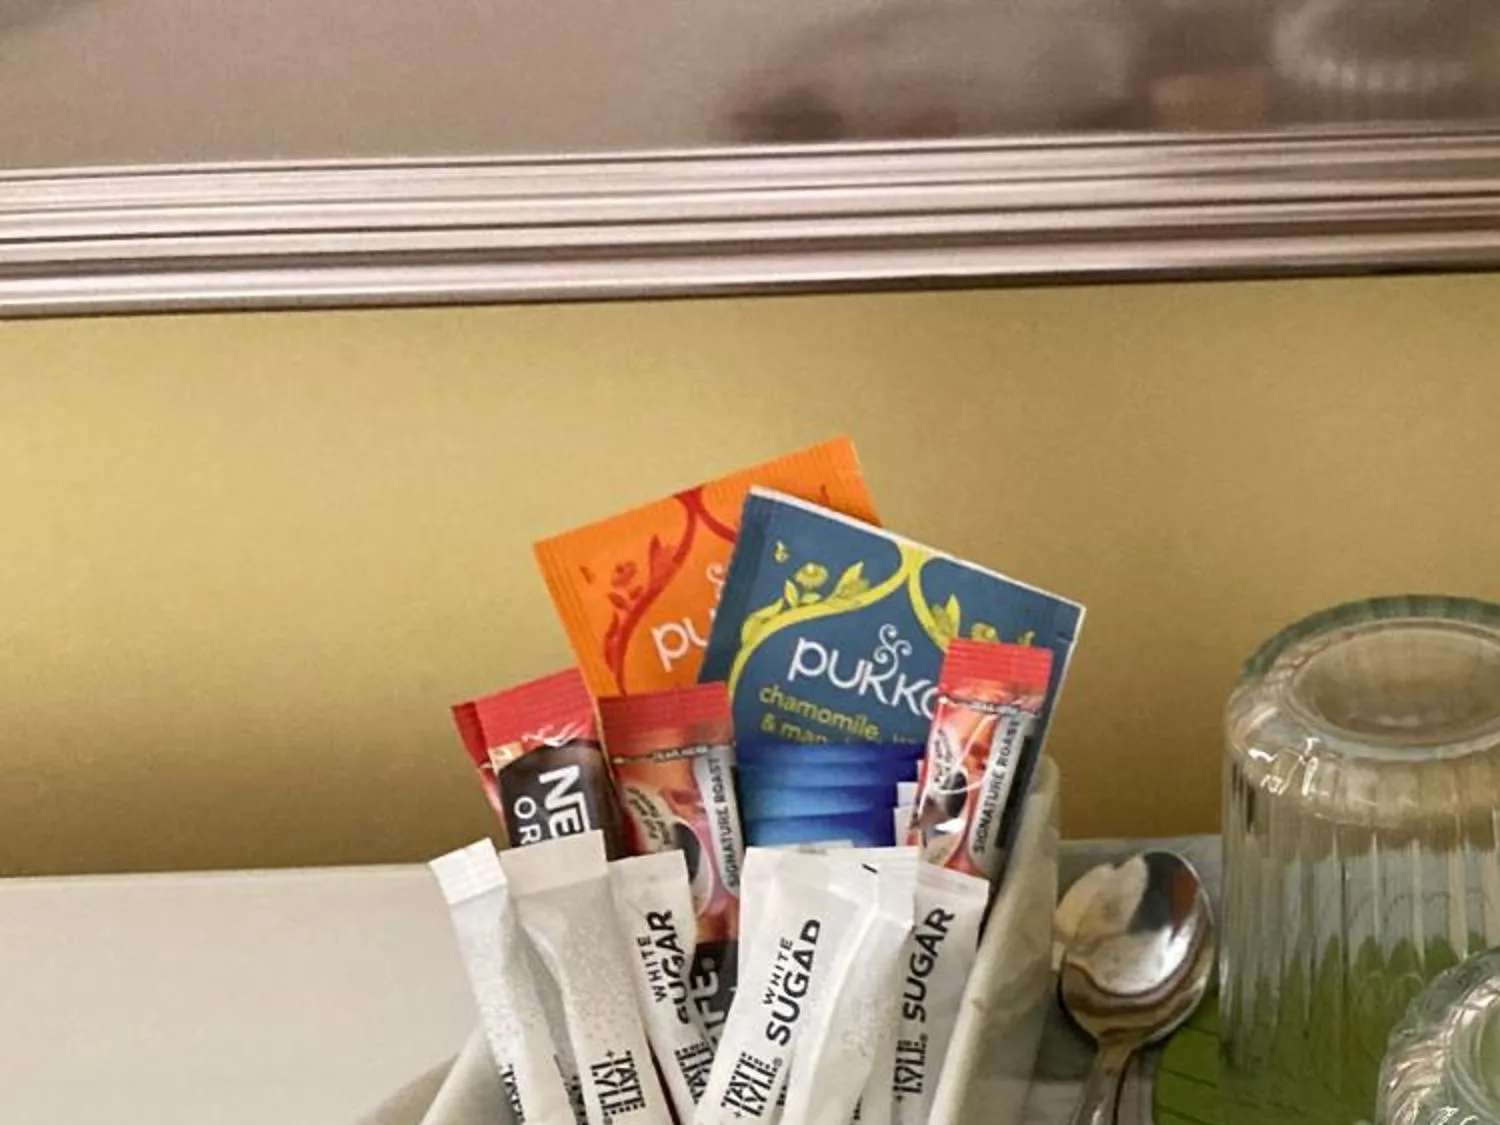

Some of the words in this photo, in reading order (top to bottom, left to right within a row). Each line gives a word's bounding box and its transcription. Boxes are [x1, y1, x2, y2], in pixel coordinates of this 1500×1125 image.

[637, 935, 668, 1003] WHITE
[763, 936, 794, 1006] WHITE
[901, 907, 956, 1023] SUGAR
